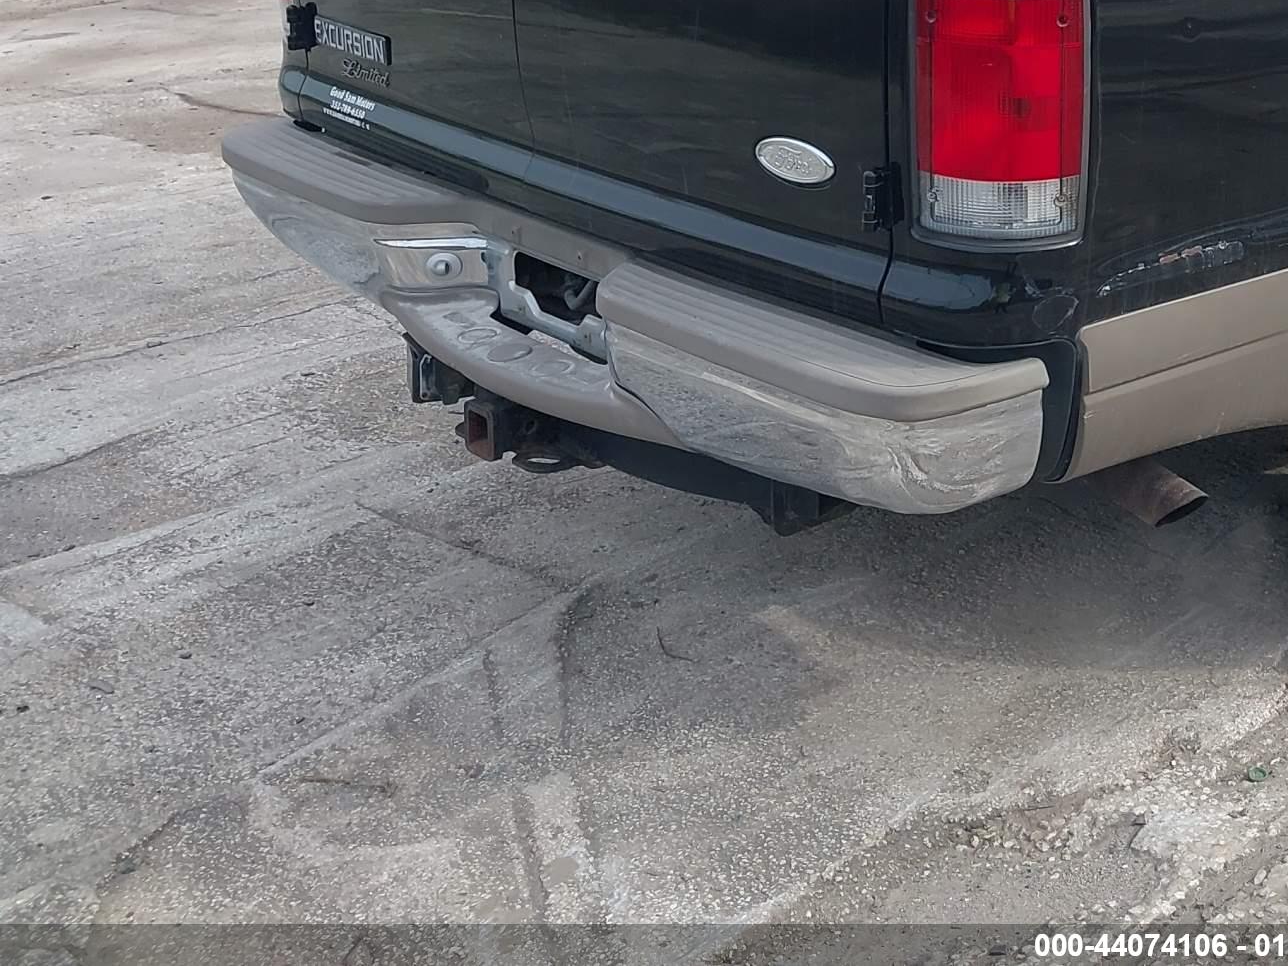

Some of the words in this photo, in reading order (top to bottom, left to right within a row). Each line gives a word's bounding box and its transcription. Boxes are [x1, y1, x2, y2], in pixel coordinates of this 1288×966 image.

[315, 18, 385, 65] EXCURSION
[342, 58, 389, 86] Limited
[330, 86, 346, 100] Good
